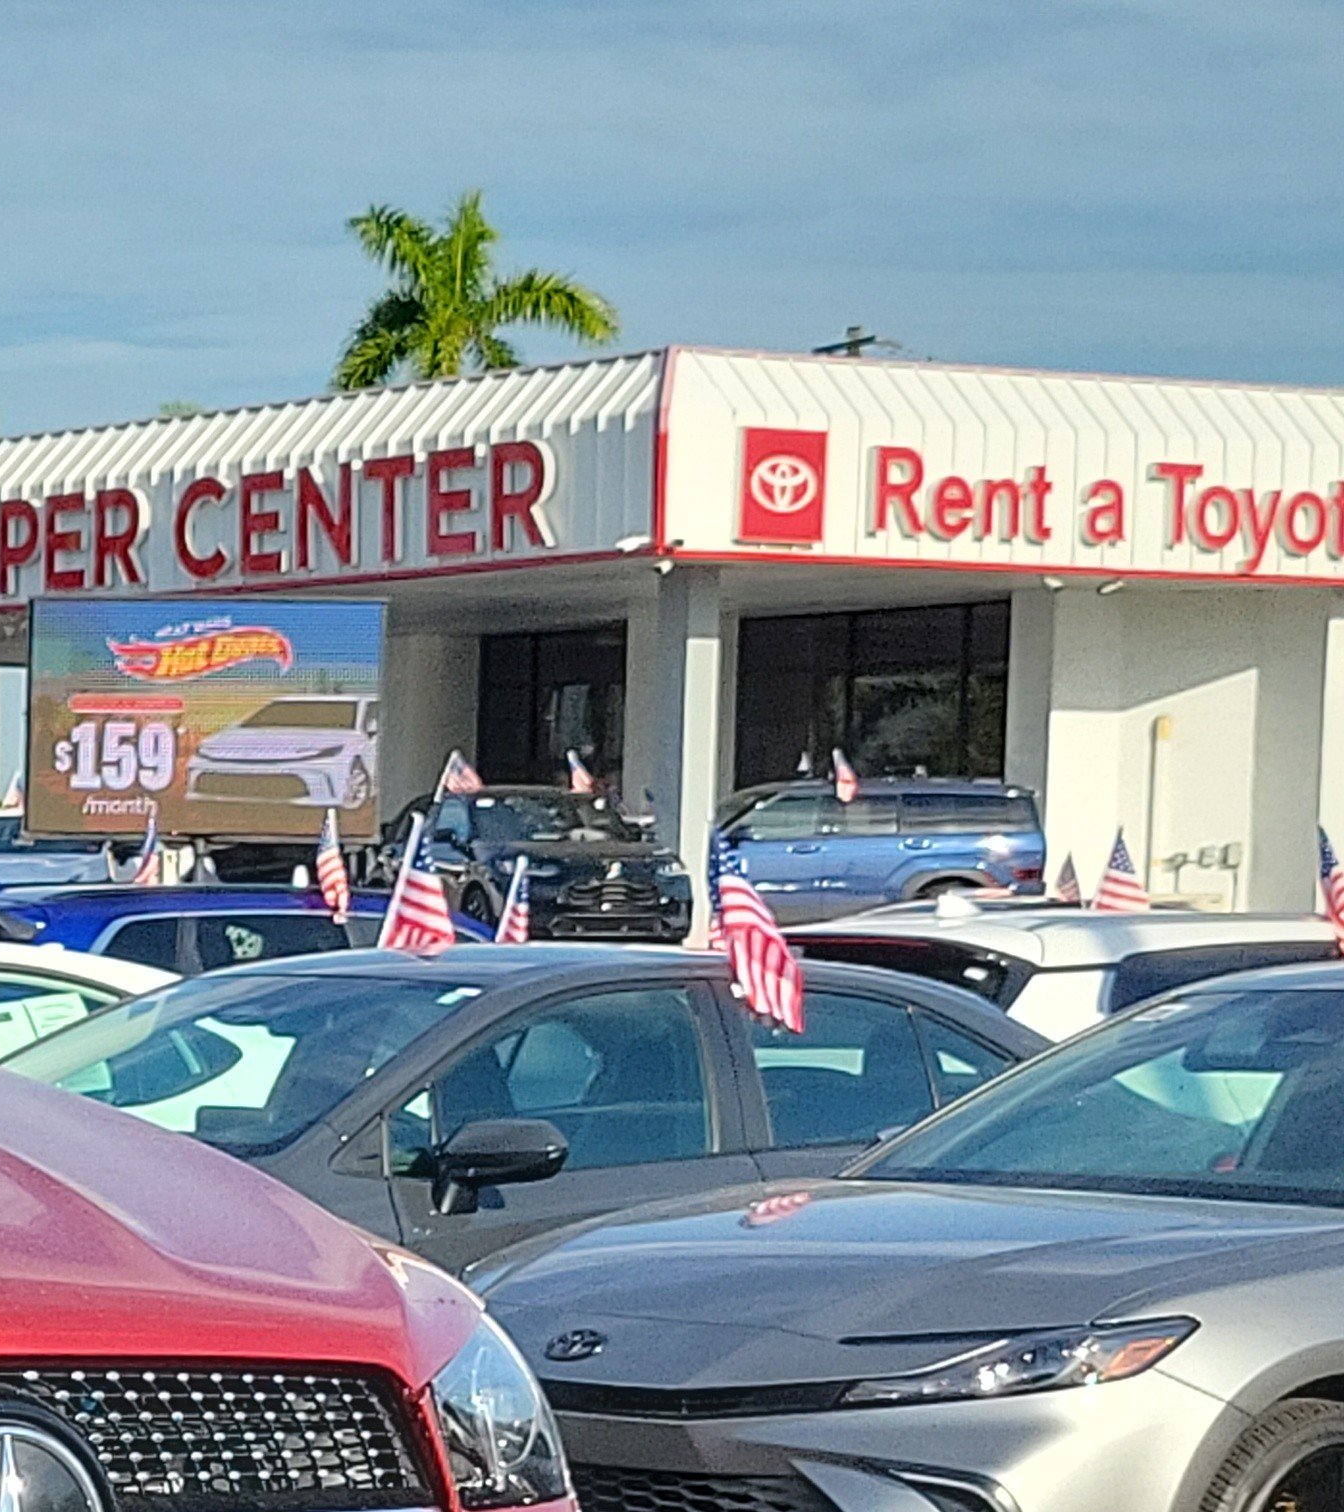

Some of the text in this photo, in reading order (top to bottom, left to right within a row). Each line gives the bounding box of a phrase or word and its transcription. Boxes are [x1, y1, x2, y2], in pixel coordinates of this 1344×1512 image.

[173, 438, 556, 581] CENTER
[868, 444, 1053, 542] Rent
[1082, 478, 1127, 546] a
